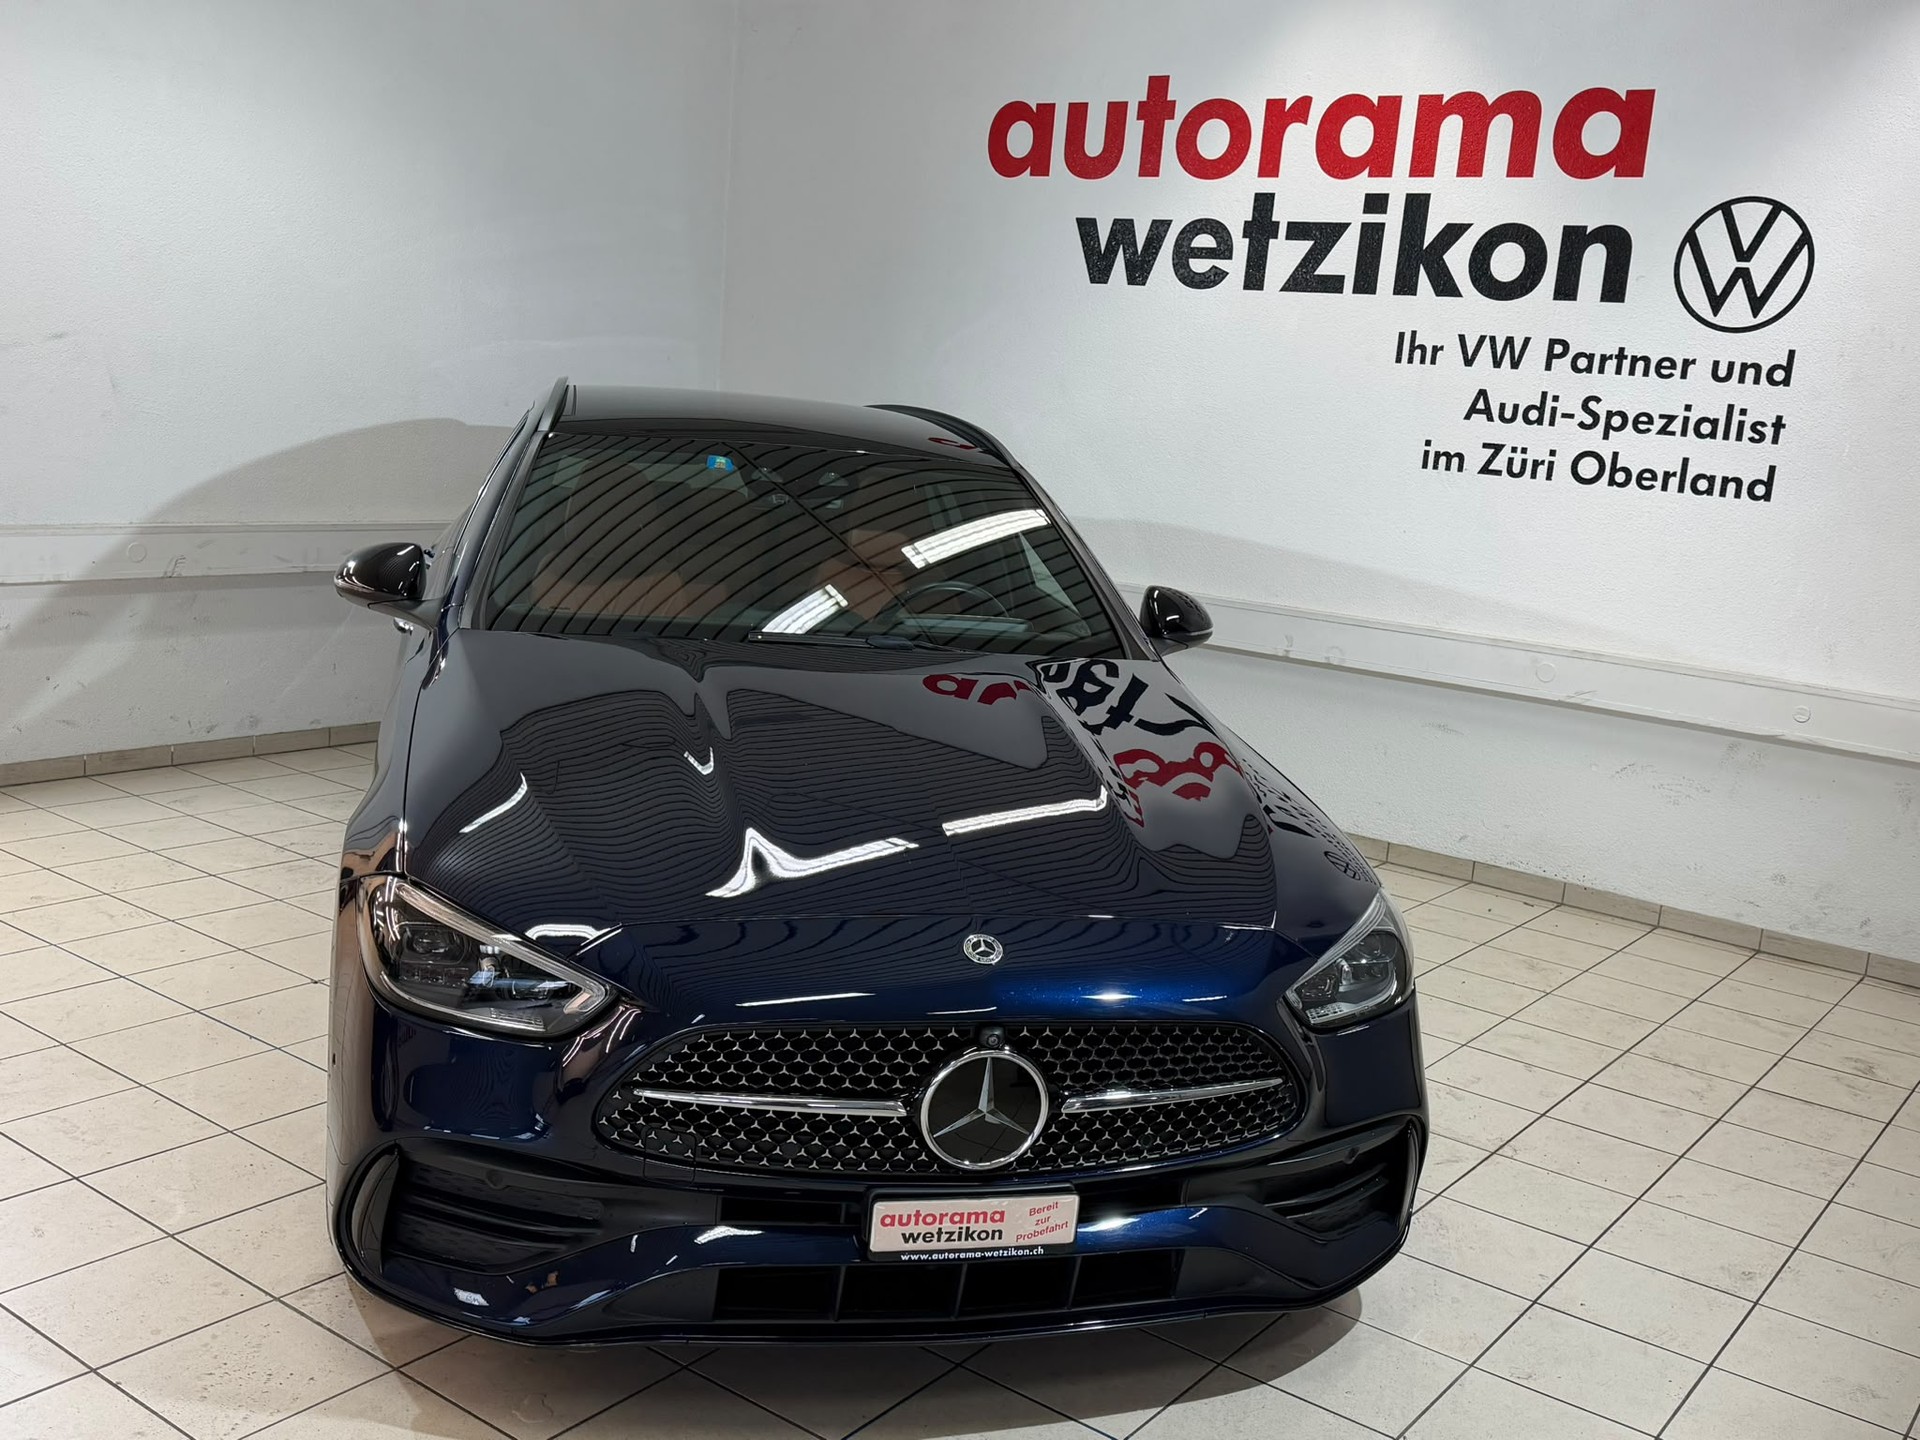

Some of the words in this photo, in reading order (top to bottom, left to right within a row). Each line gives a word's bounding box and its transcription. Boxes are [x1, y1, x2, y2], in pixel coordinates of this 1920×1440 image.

[988, 75, 1656, 181] autorama
[1076, 192, 1633, 304] wetzikon
[1394, 330, 1444, 370] Ihr
[1458, 334, 1531, 370] VW
[1545, 338, 1696, 381] Partner
[1712, 349, 1796, 388] und
[1464, 388, 1787, 446] Audi-Spezialist
[1421, 439, 1465, 474] im
[1477, 442, 1557, 486] Züri
[1570, 450, 1777, 503] Oberland
[880, 1209, 1006, 1228] autorama
[1029, 1201, 1060, 1218] Bereit
[1034, 1215, 1052, 1227] zur
[901, 1226, 1003, 1245] wetzikon
[1015, 1220, 1069, 1243] Probefahrt
[900, 1246, 1045, 1261] www.autorama-wetzikon.ch
